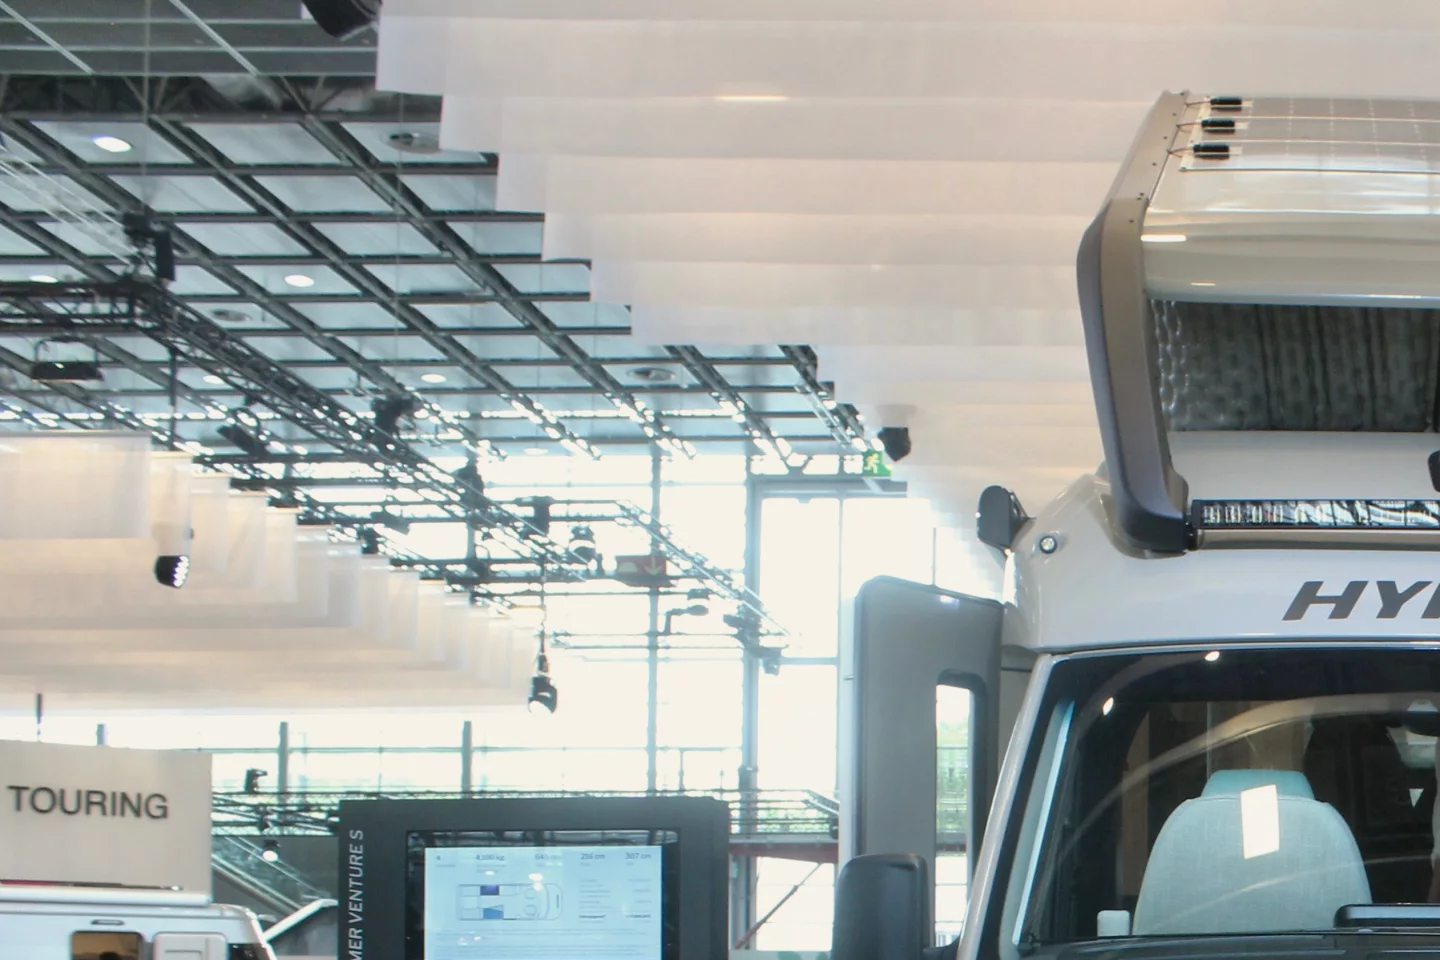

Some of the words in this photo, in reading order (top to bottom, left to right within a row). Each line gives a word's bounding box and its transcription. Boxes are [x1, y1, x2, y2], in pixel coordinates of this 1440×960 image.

[8, 785, 169, 819] TOURING
[349, 829, 364, 840] S
[348, 844, 364, 923] VENTURE
